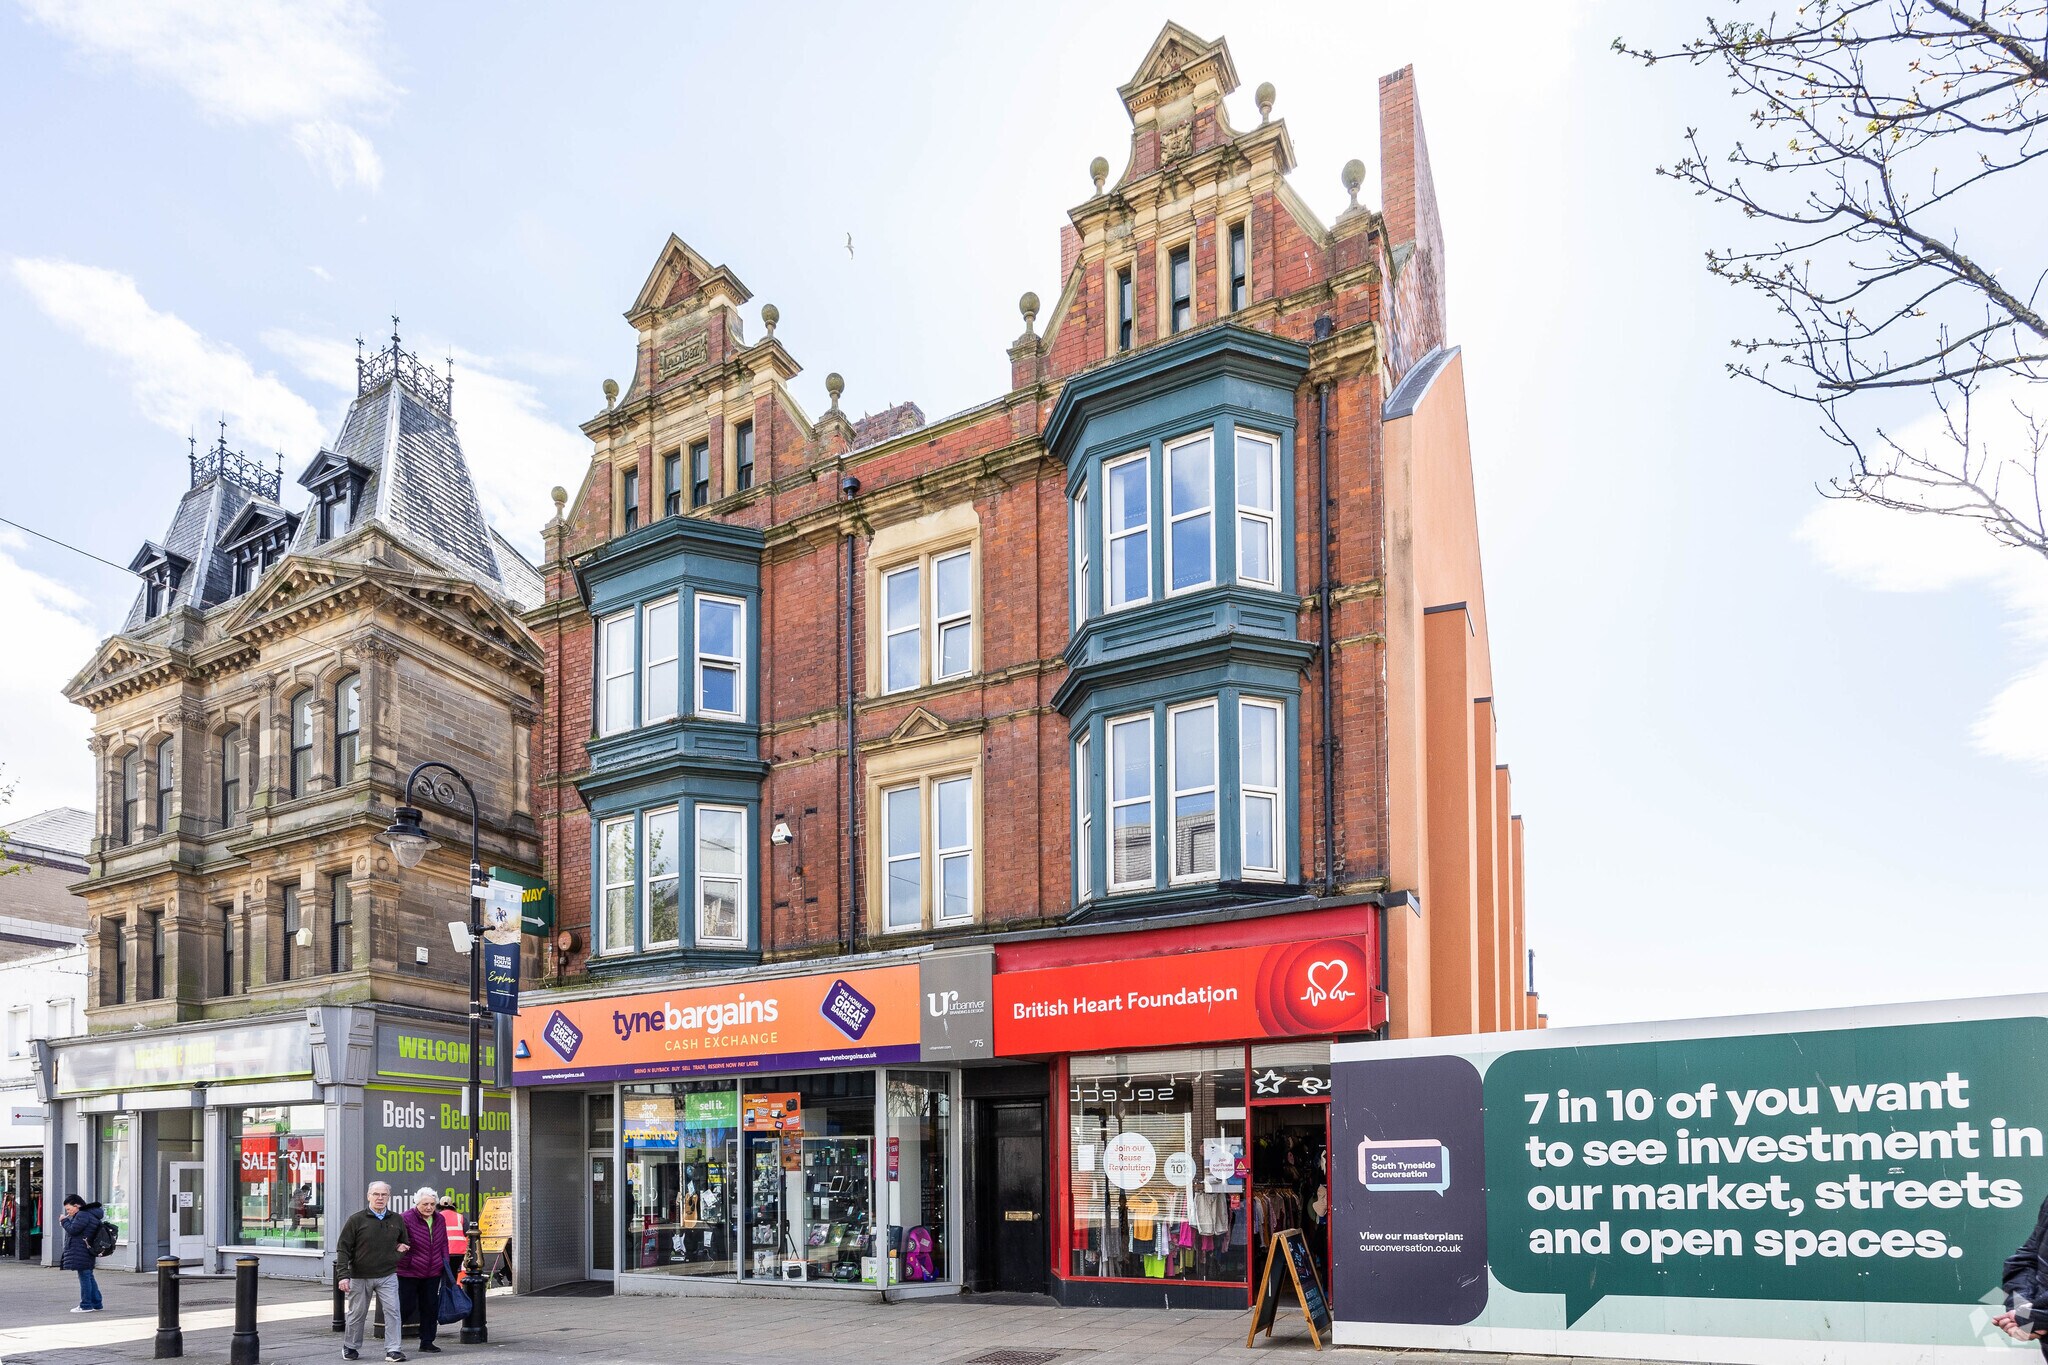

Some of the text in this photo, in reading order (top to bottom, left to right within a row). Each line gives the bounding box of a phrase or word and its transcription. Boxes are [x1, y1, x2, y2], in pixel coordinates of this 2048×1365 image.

[488, 970, 516, 985] Explore
[834, 995, 867, 1024] GREAT
[839, 988, 870, 1014] THE HOME OF
[949, 1000, 986, 1010] urbanriver
[1013, 986, 1238, 1020] British Heart Foundation
[556, 1017, 564, 1026] THE
[613, 993, 779, 1041] tynebargains
[553, 1023, 576, 1048] GREAT
[665, 1032, 778, 1051] CASH EXCHANGE
[974, 1039, 984, 1048] 75
[398, 1035, 482, 1066] WELCOM
[819, 1052, 877, 1062] www.tynebargains.co.uk
[642, 1102, 658, 1112] shop
[699, 1100, 725, 1111] sell it.
[1524, 1072, 1969, 1126] 7 in 10 of you want
[383, 1100, 425, 1129] Beds
[1114, 1144, 1131, 1152] Join
[1525, 1117, 2043, 1168] to see investment in
[241, 1152, 277, 1171] SALE
[289, 1151, 325, 1171] SALE
[375, 1144, 425, 1172] Sofas
[440, 1145, 512, 1176] Uphlster
[1118, 1153, 1142, 1162] Reuse
[1371, 1154, 1387, 1162] Our
[1371, 1160, 1436, 1171] South Tyneside
[1108, 1163, 1151, 1172] Revolution
[1371, 1169, 1428, 1179] Conversation
[1527, 1171, 2023, 1217] our market, streets
[1359, 1231, 1464, 1243] View our masterplan:
[1529, 1220, 1963, 1266] and open spaces.
[1359, 1243, 1462, 1254] ourconversation.co.uk
